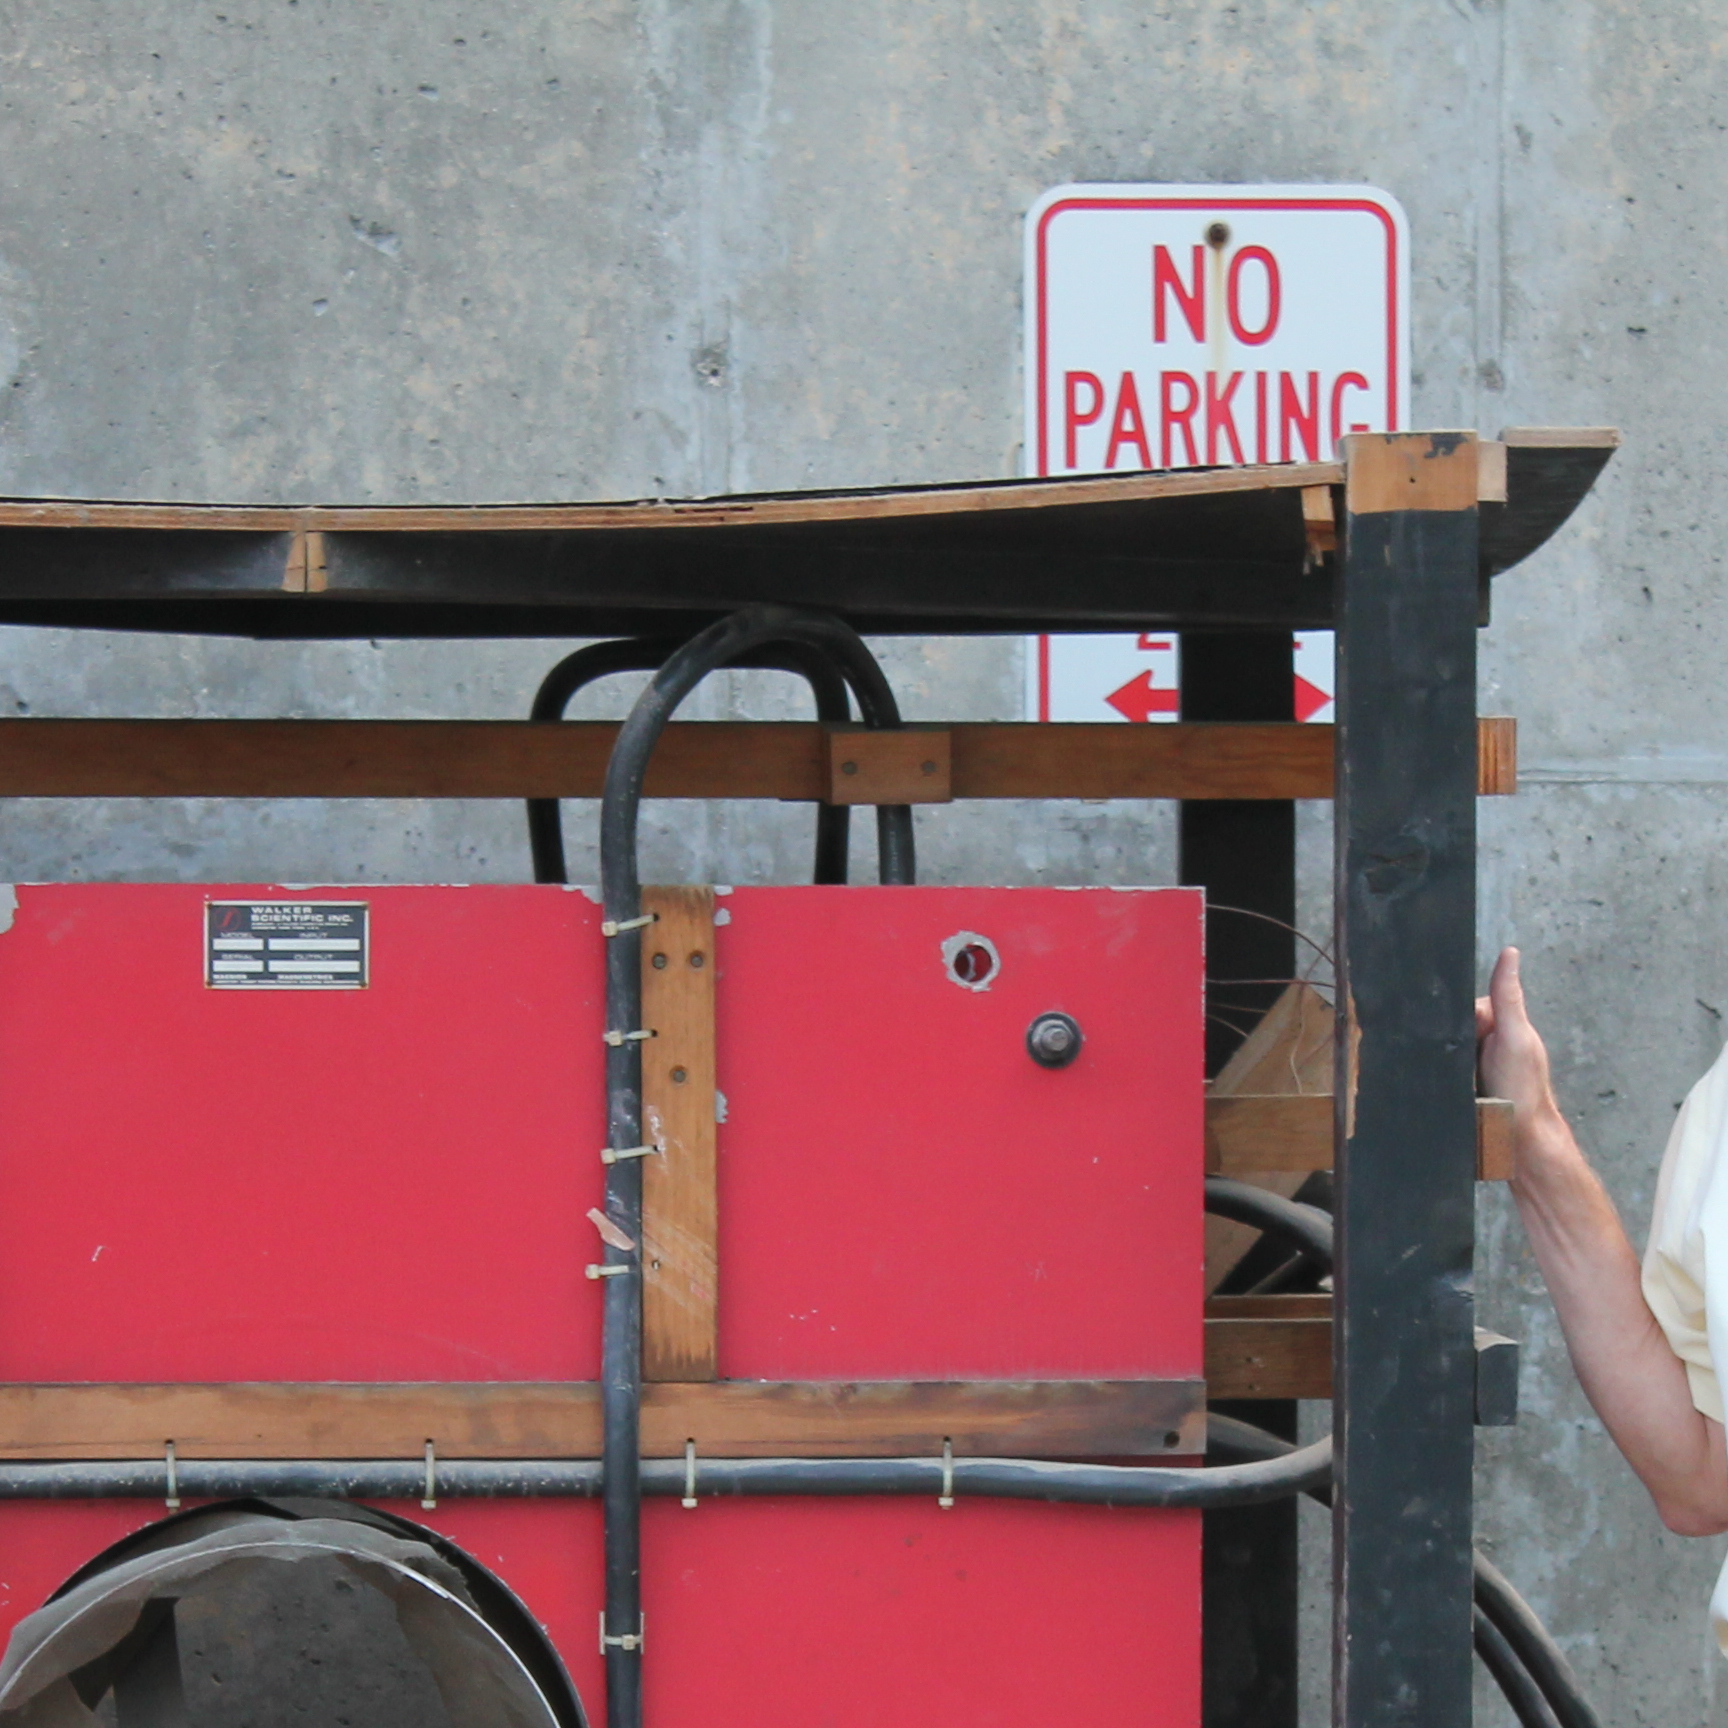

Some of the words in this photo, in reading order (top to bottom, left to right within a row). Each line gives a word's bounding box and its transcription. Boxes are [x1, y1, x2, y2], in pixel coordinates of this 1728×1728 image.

[1153, 245, 1281, 346] NO
[1065, 371, 1369, 470] PARKING
[250, 914, 324, 922] SCIENTIFIC
